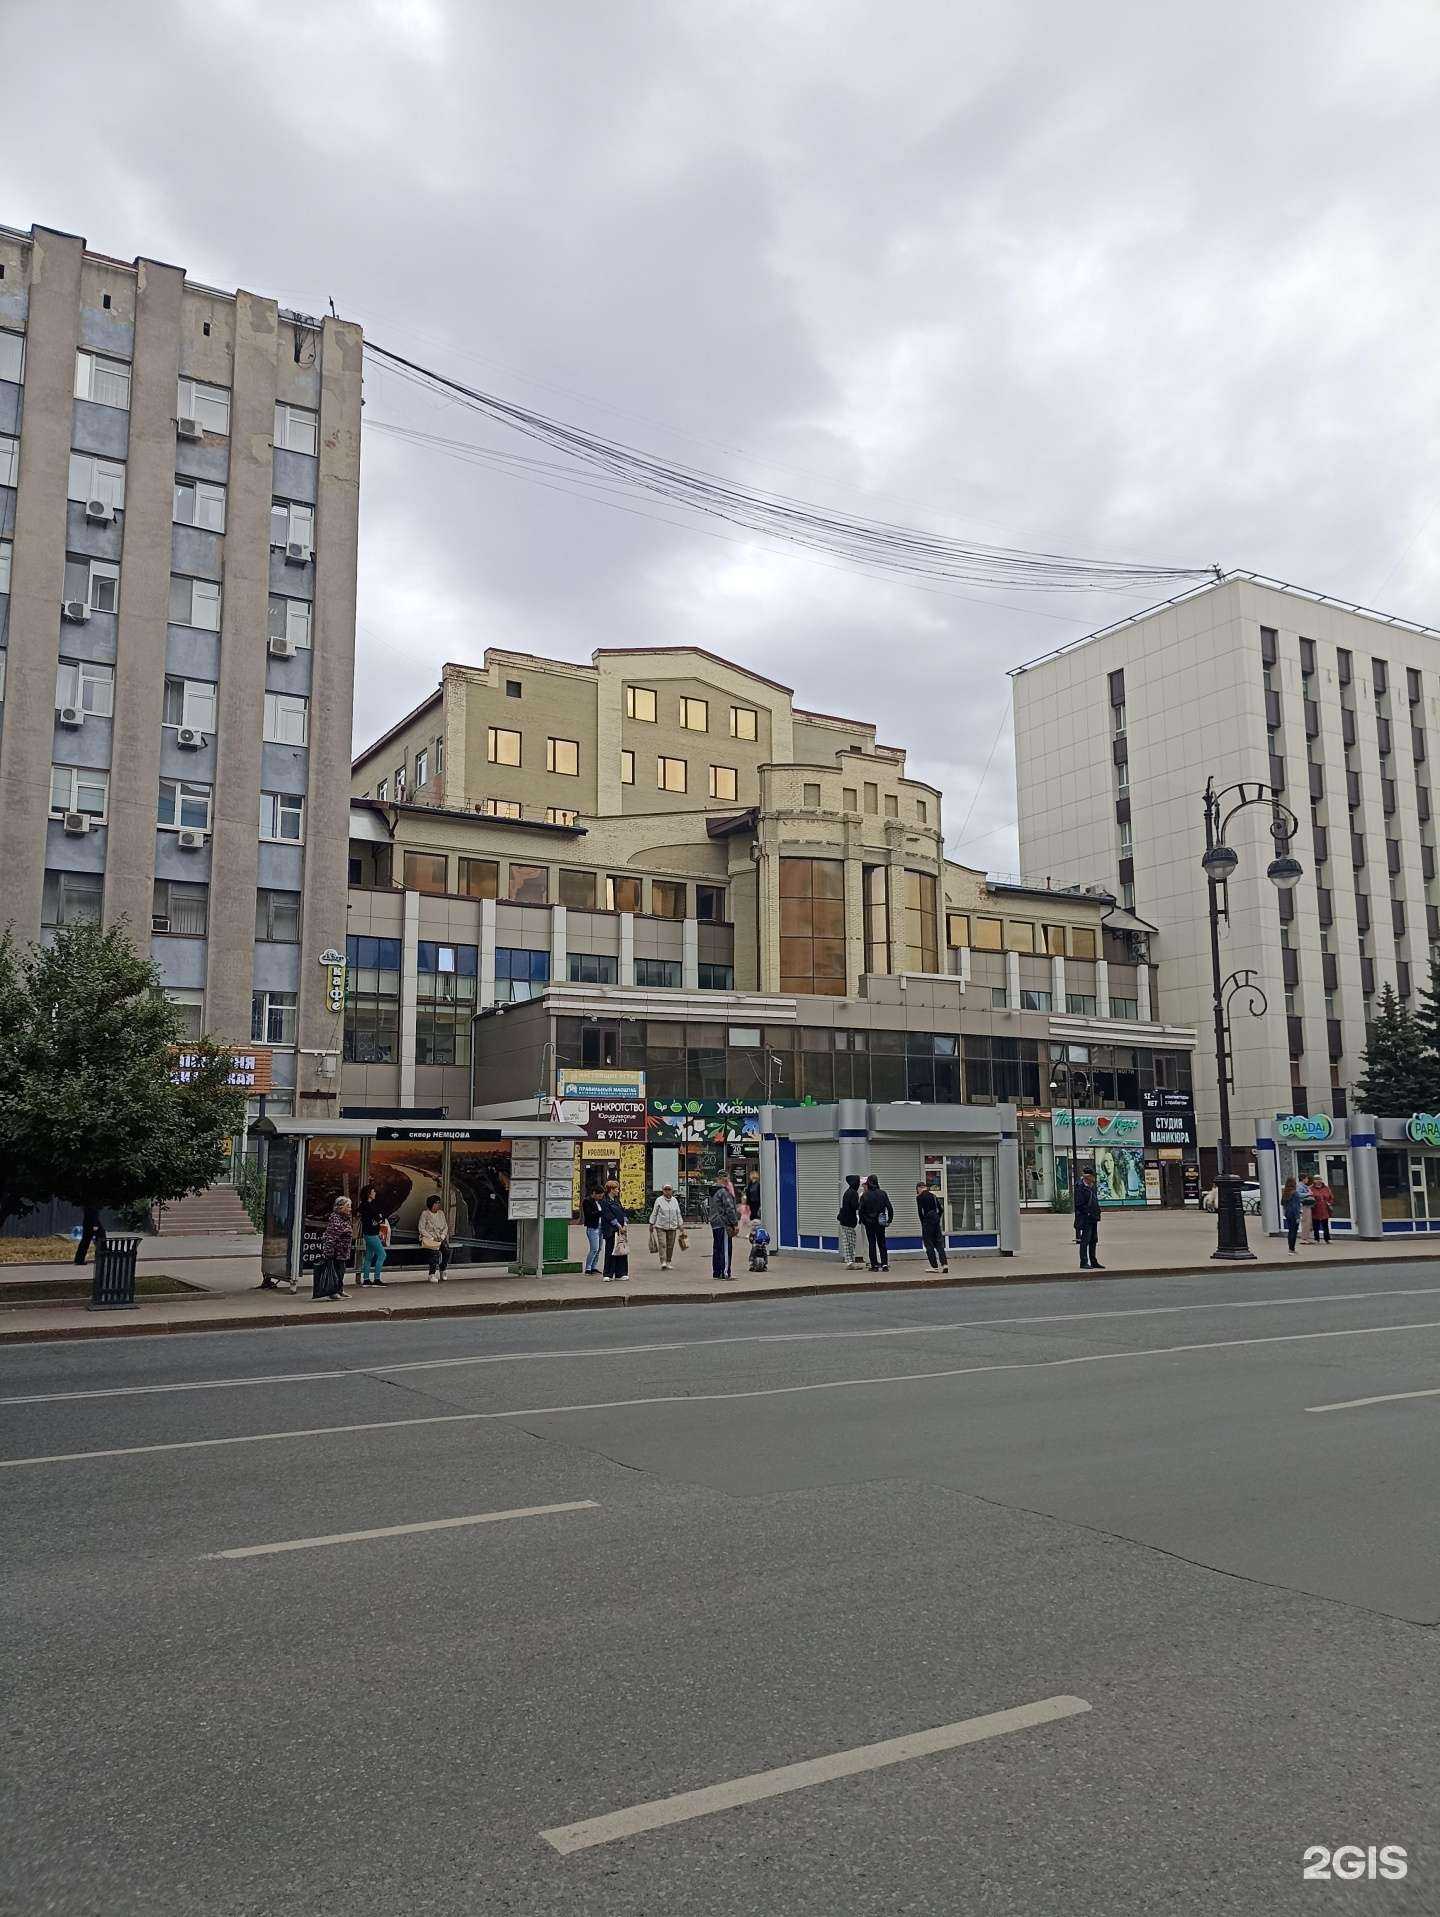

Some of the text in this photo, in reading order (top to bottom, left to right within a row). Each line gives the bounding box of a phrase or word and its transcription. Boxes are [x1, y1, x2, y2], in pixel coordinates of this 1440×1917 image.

[330, 967, 344, 1010] кафе
[590, 1102, 645, 1112] БАНКРОТСТВО
[1155, 1117, 1183, 1129] СТУДИЯ
[408, 1131, 470, 1140] сквер НЕМЦОВА
[608, 1130, 639, 1139] 912-112
[1150, 1131, 1190, 1143] МАНИКЮРА
[312, 1142, 349, 1160] 437
